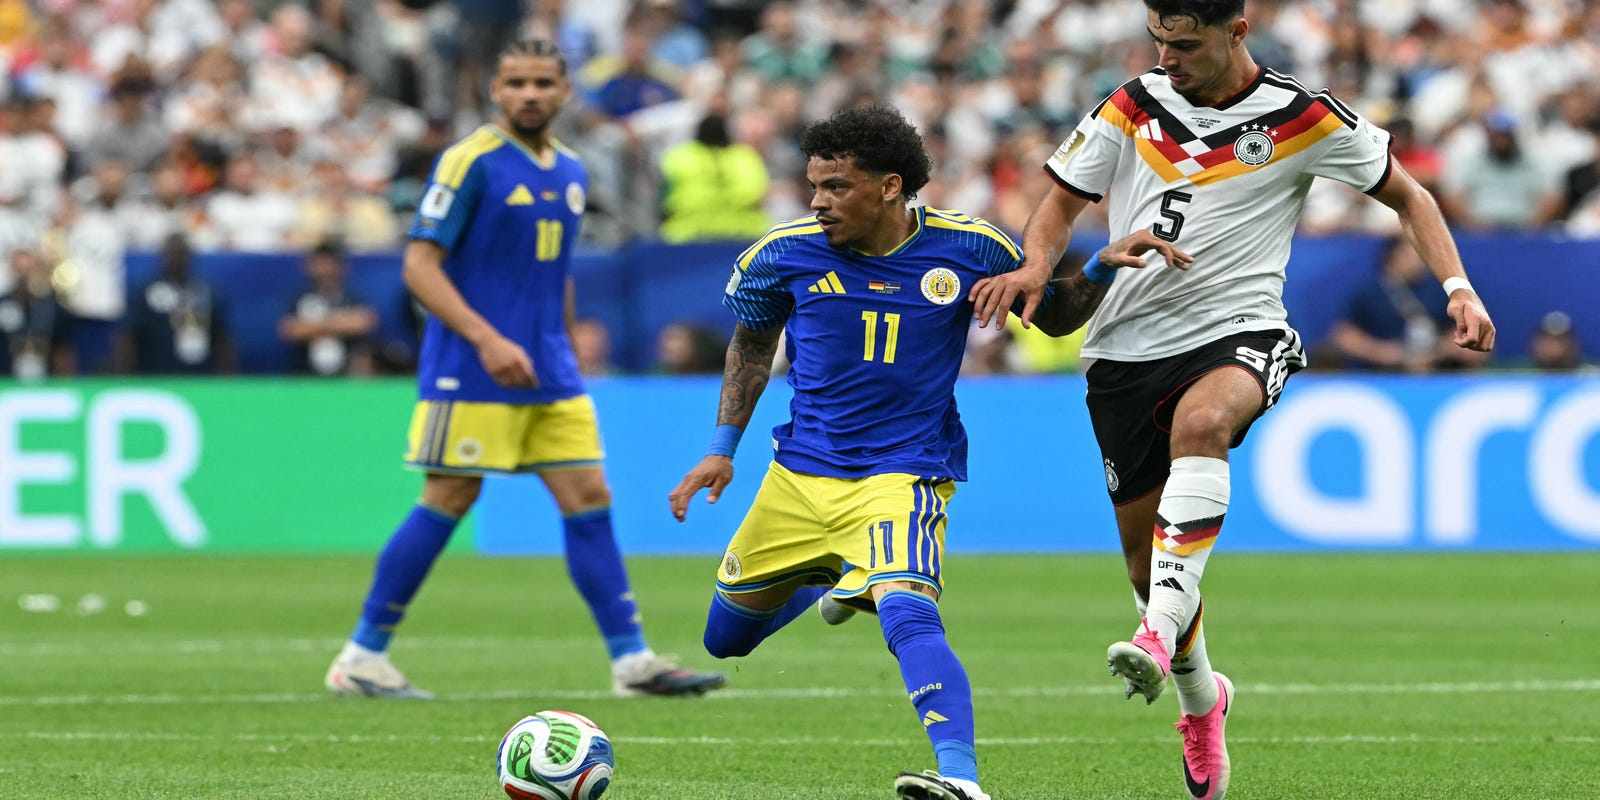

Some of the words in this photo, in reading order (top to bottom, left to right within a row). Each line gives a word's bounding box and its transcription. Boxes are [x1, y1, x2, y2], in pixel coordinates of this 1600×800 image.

[535, 218, 564, 261] 10
[1152, 190, 1192, 242] 5
[862, 310, 900, 364] 11
[0, 387, 207, 547] ER
[869, 520, 893, 568] 11
[1158, 560, 1184, 571] DFB
